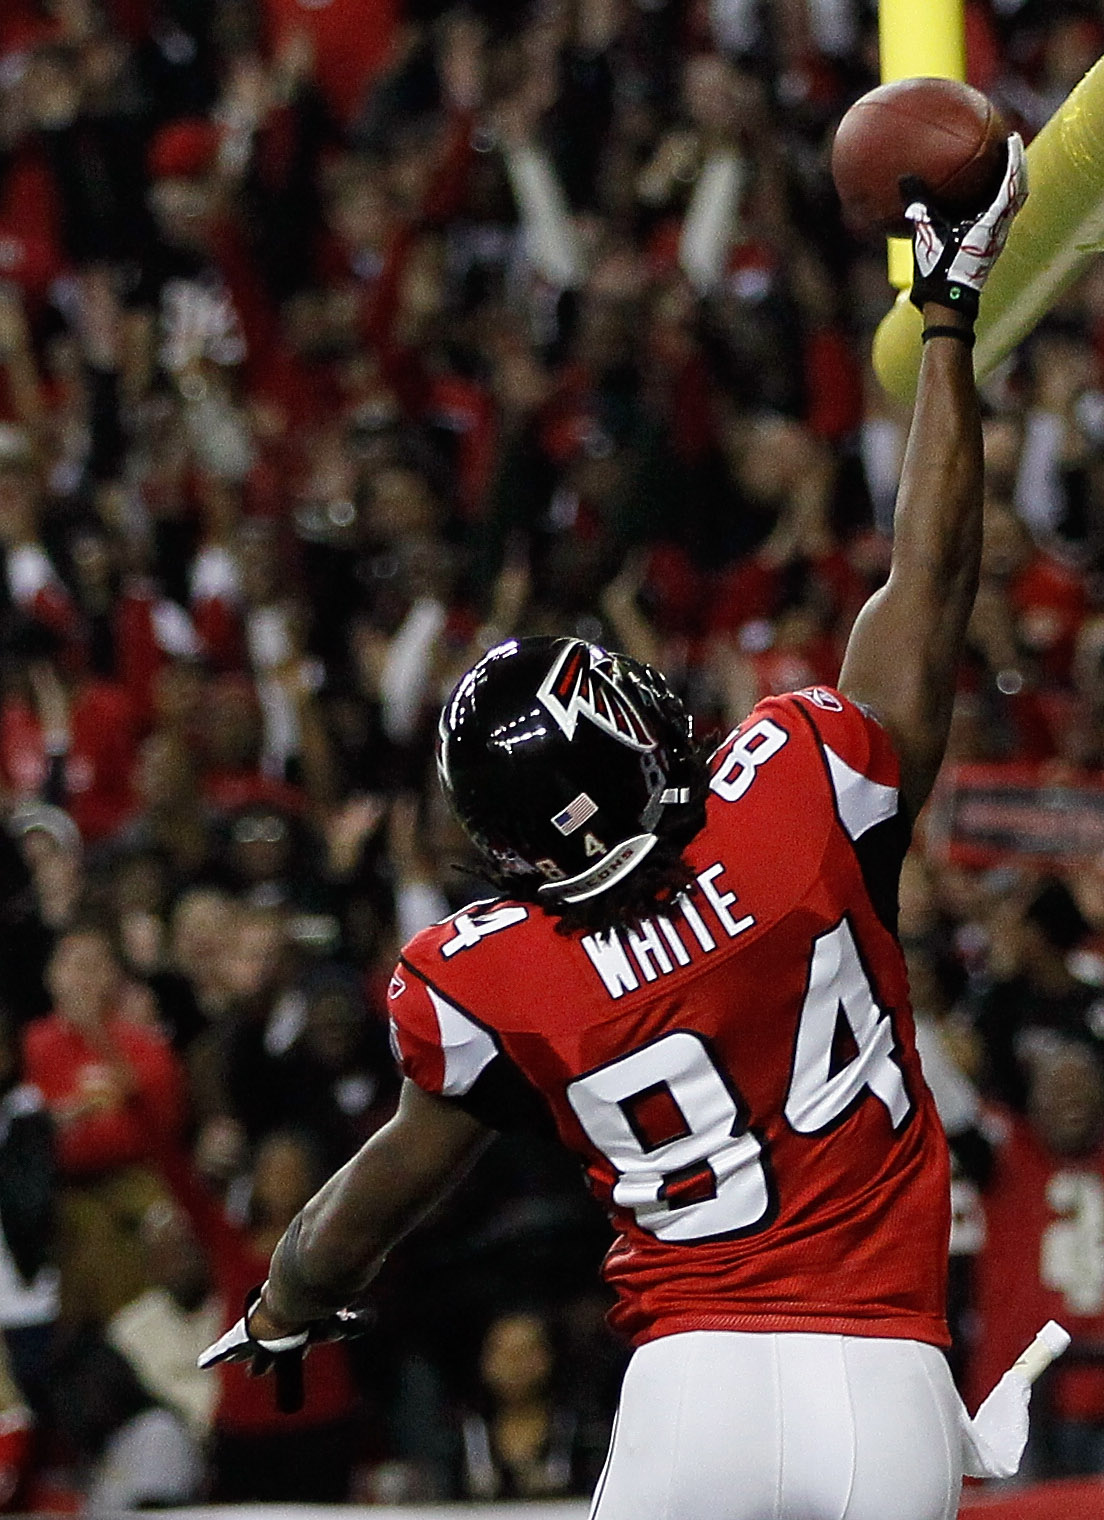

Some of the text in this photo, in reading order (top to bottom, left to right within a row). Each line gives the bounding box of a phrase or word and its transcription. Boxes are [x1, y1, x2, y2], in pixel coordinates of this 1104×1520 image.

[706, 718, 789, 803] 8
[580, 862, 756, 1000] WHITE
[566, 918, 912, 1242] 84
